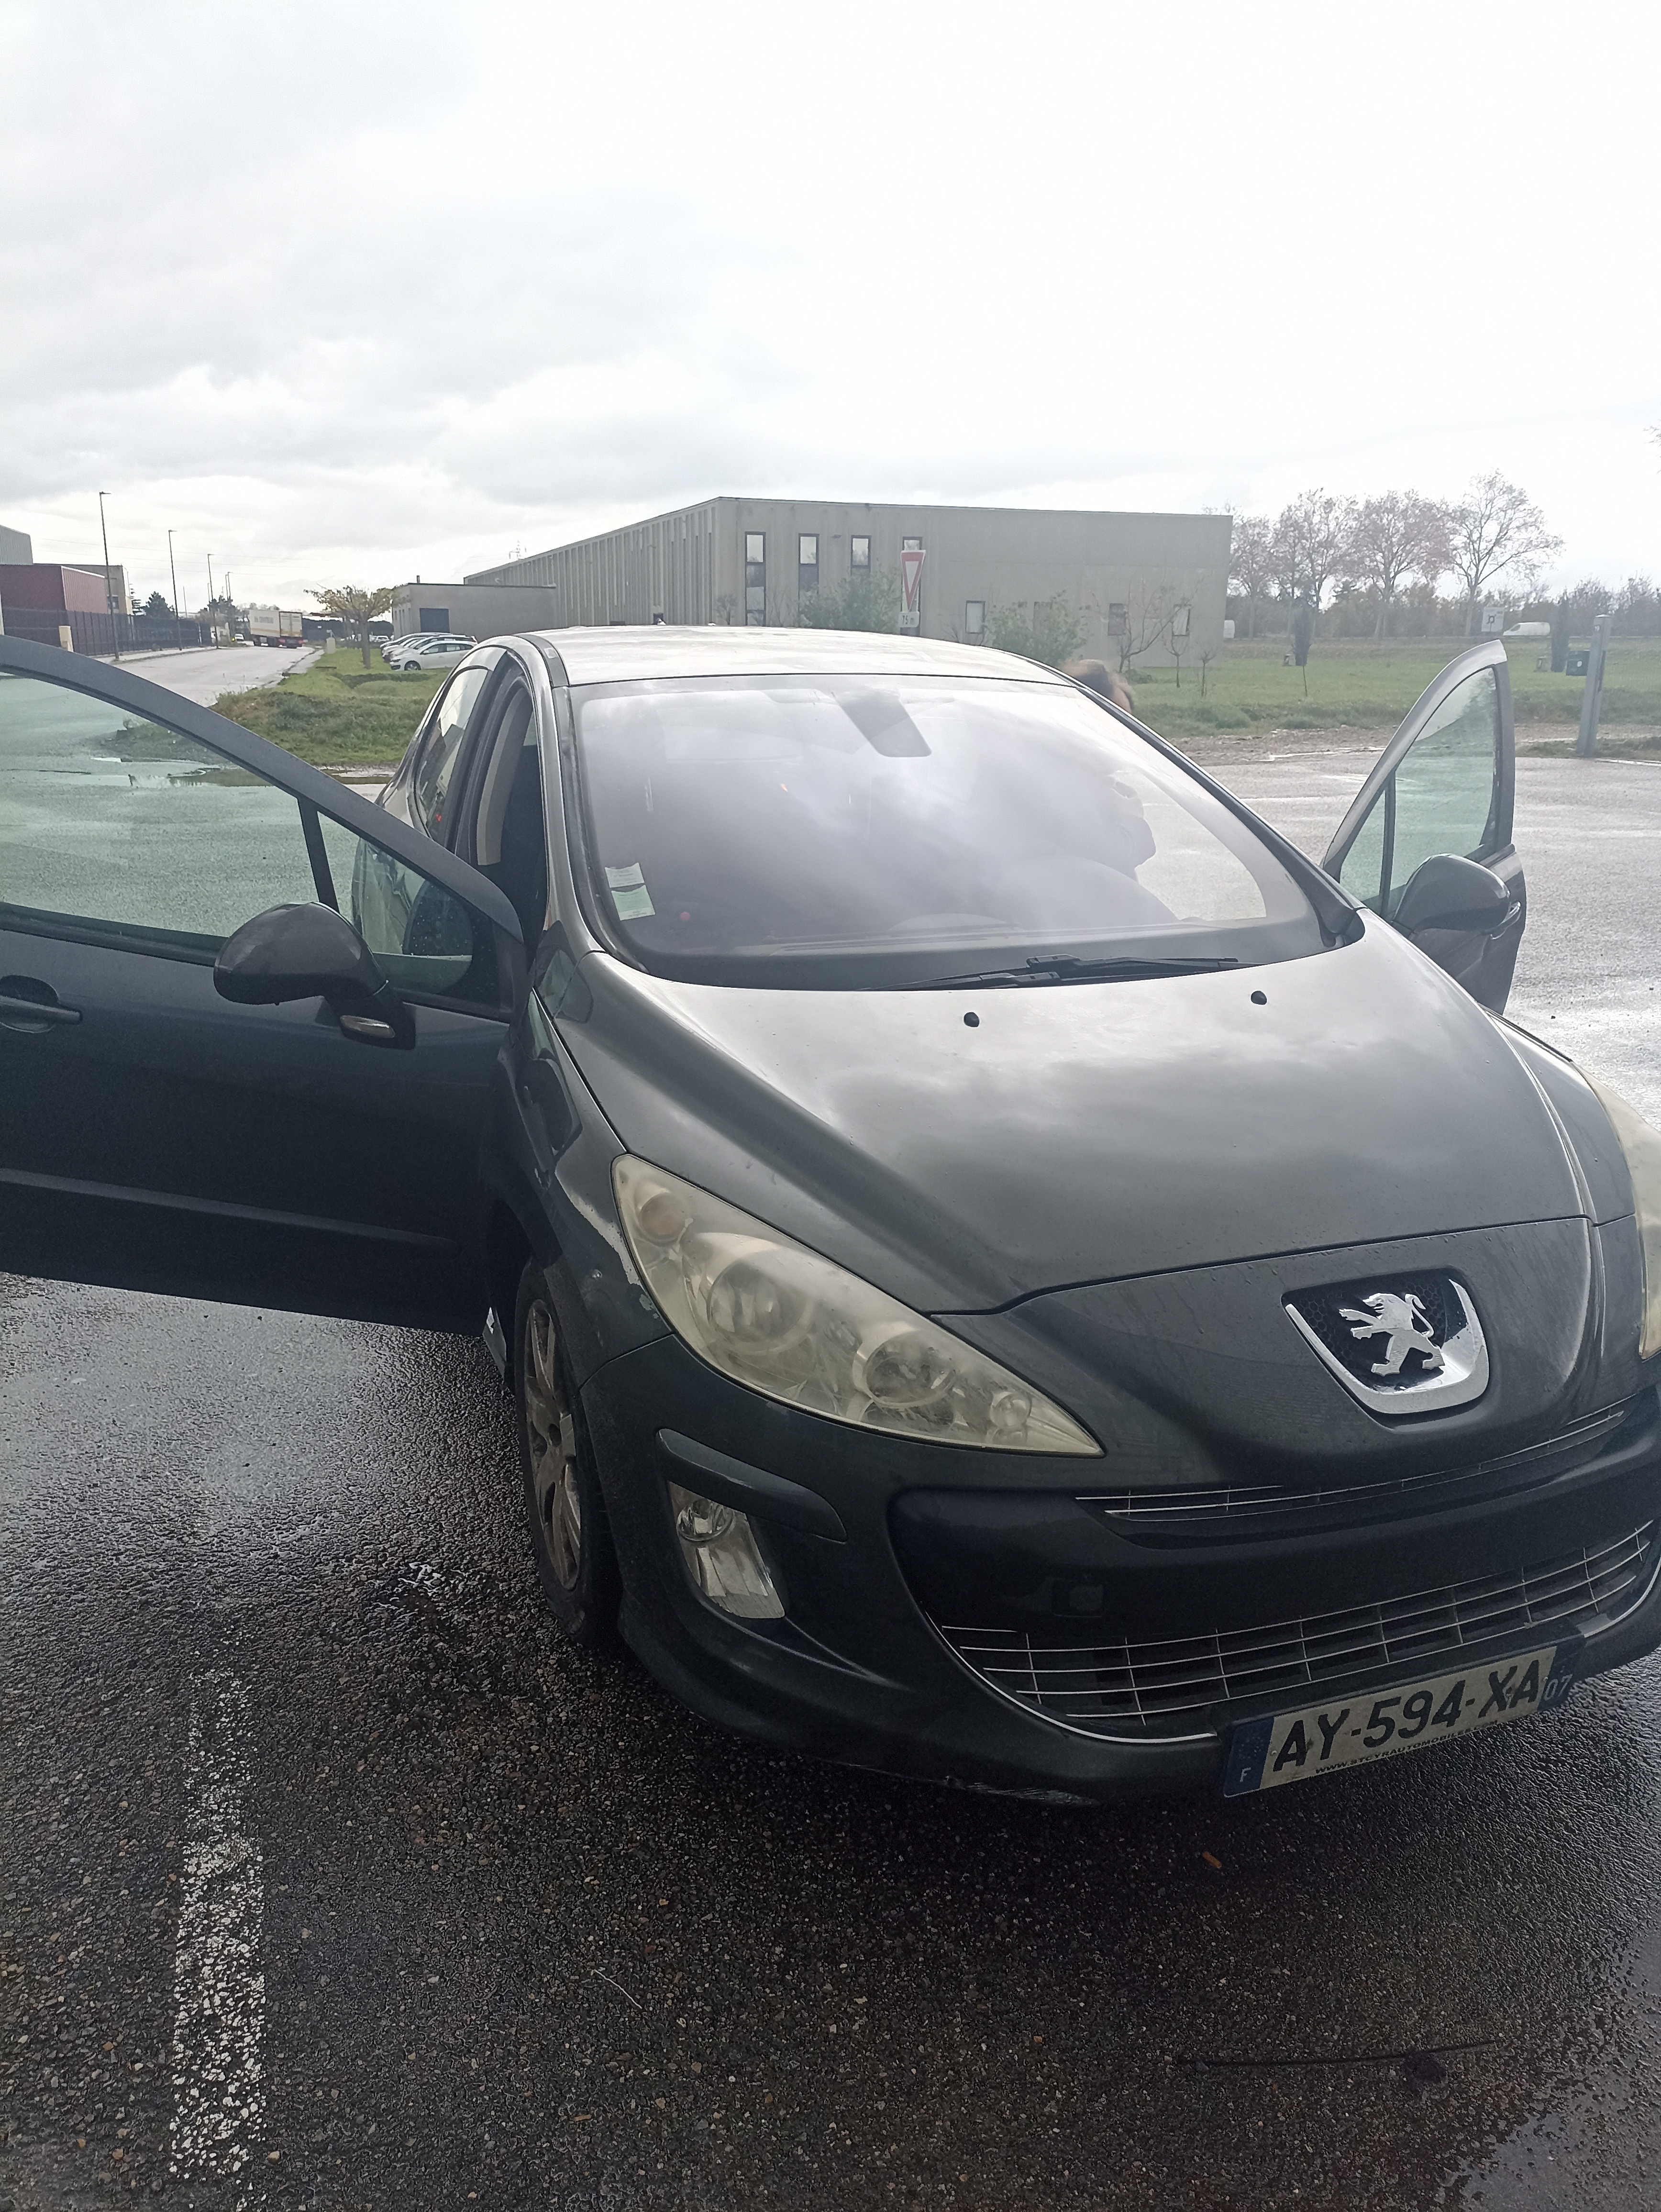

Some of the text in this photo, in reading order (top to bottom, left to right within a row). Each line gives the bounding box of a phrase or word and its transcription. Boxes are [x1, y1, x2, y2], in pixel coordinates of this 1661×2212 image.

[1543, 1674, 1573, 1701] 07
[1273, 1659, 1539, 1771] AY-594-XA
[1240, 1767, 1251, 1782] F
